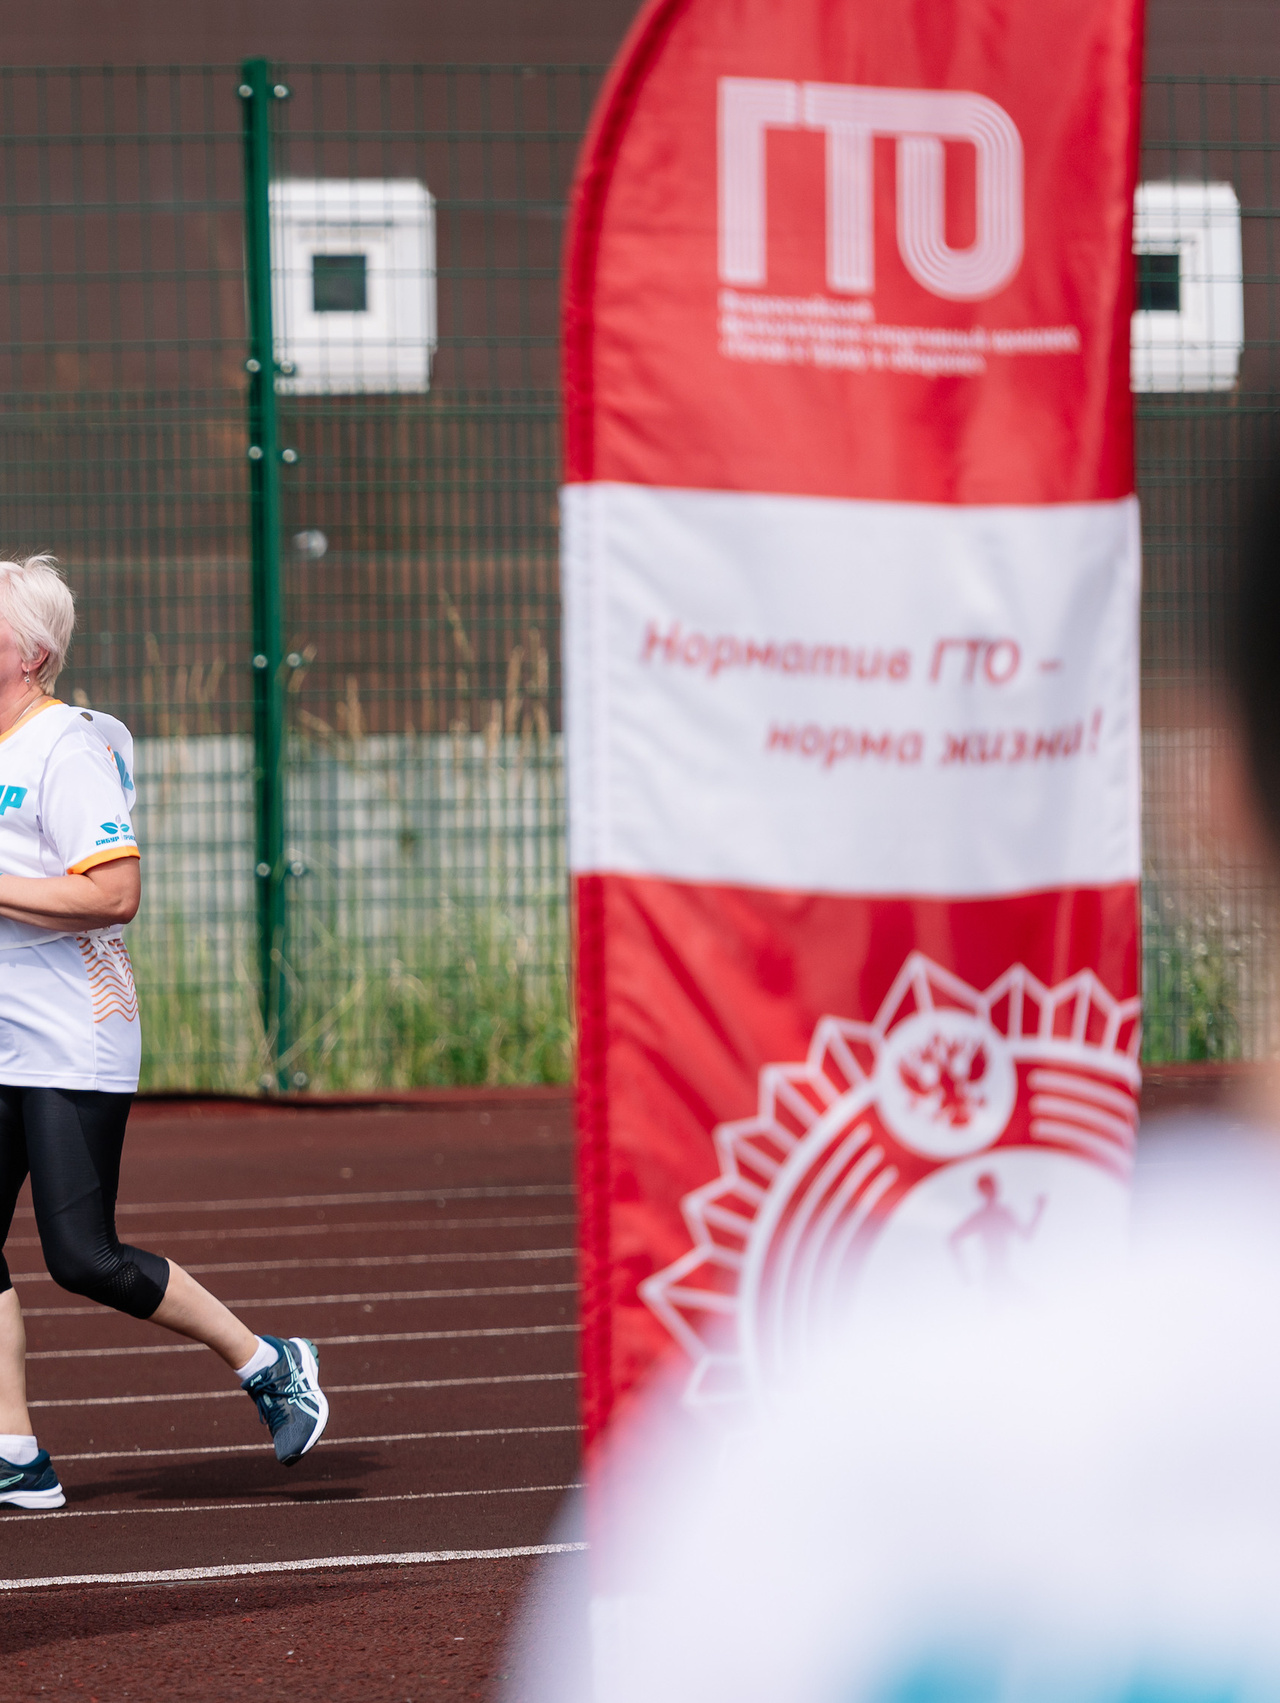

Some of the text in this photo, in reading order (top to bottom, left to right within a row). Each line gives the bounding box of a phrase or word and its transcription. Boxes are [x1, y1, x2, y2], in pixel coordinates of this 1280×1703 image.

[717, 76, 1025, 302] ГТО
[640, 619, 913, 681] Норматив
[929, 634, 1022, 685] ГТО
[766, 706, 1104, 768] норма жизни!
[95, 836, 120, 846] СИБУР
